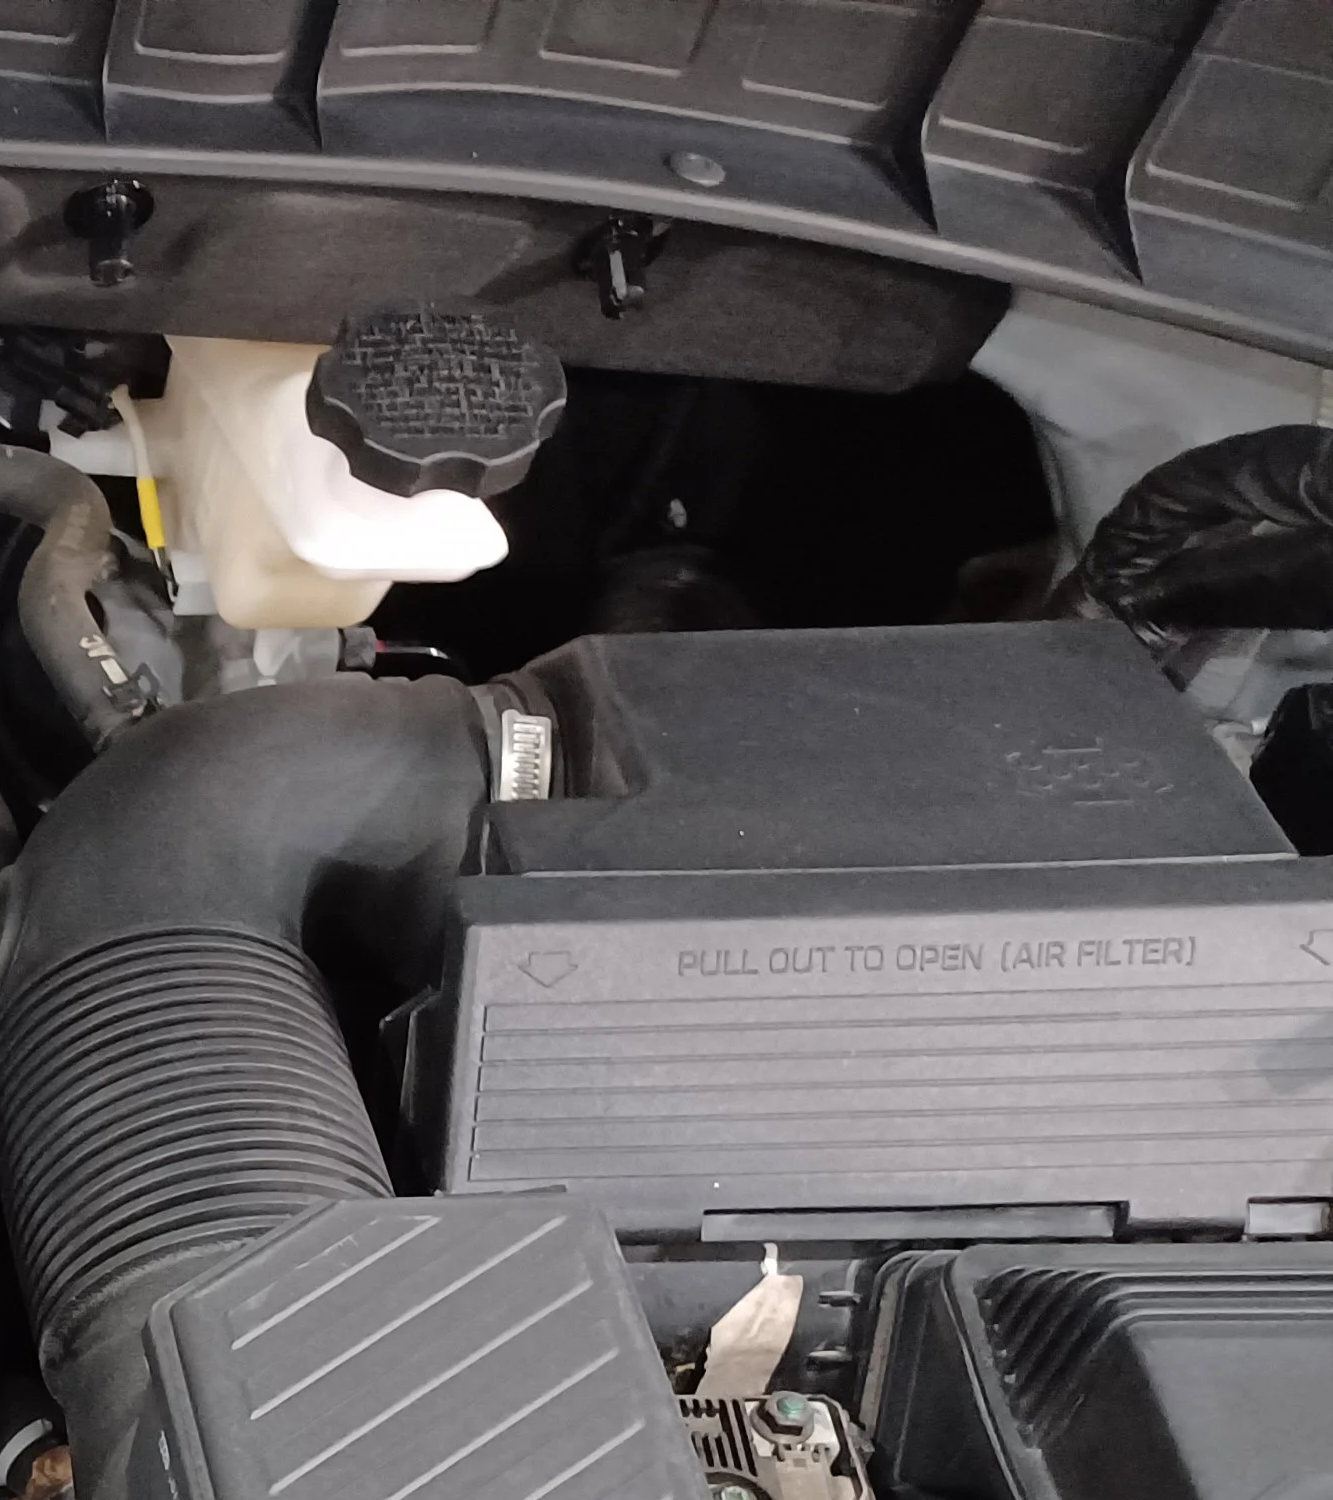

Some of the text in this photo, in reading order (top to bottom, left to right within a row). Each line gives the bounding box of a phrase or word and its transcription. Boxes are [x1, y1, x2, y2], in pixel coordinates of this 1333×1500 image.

[678, 936, 1197, 977] PULL OUT TO OPEN (AIR FILTER)
